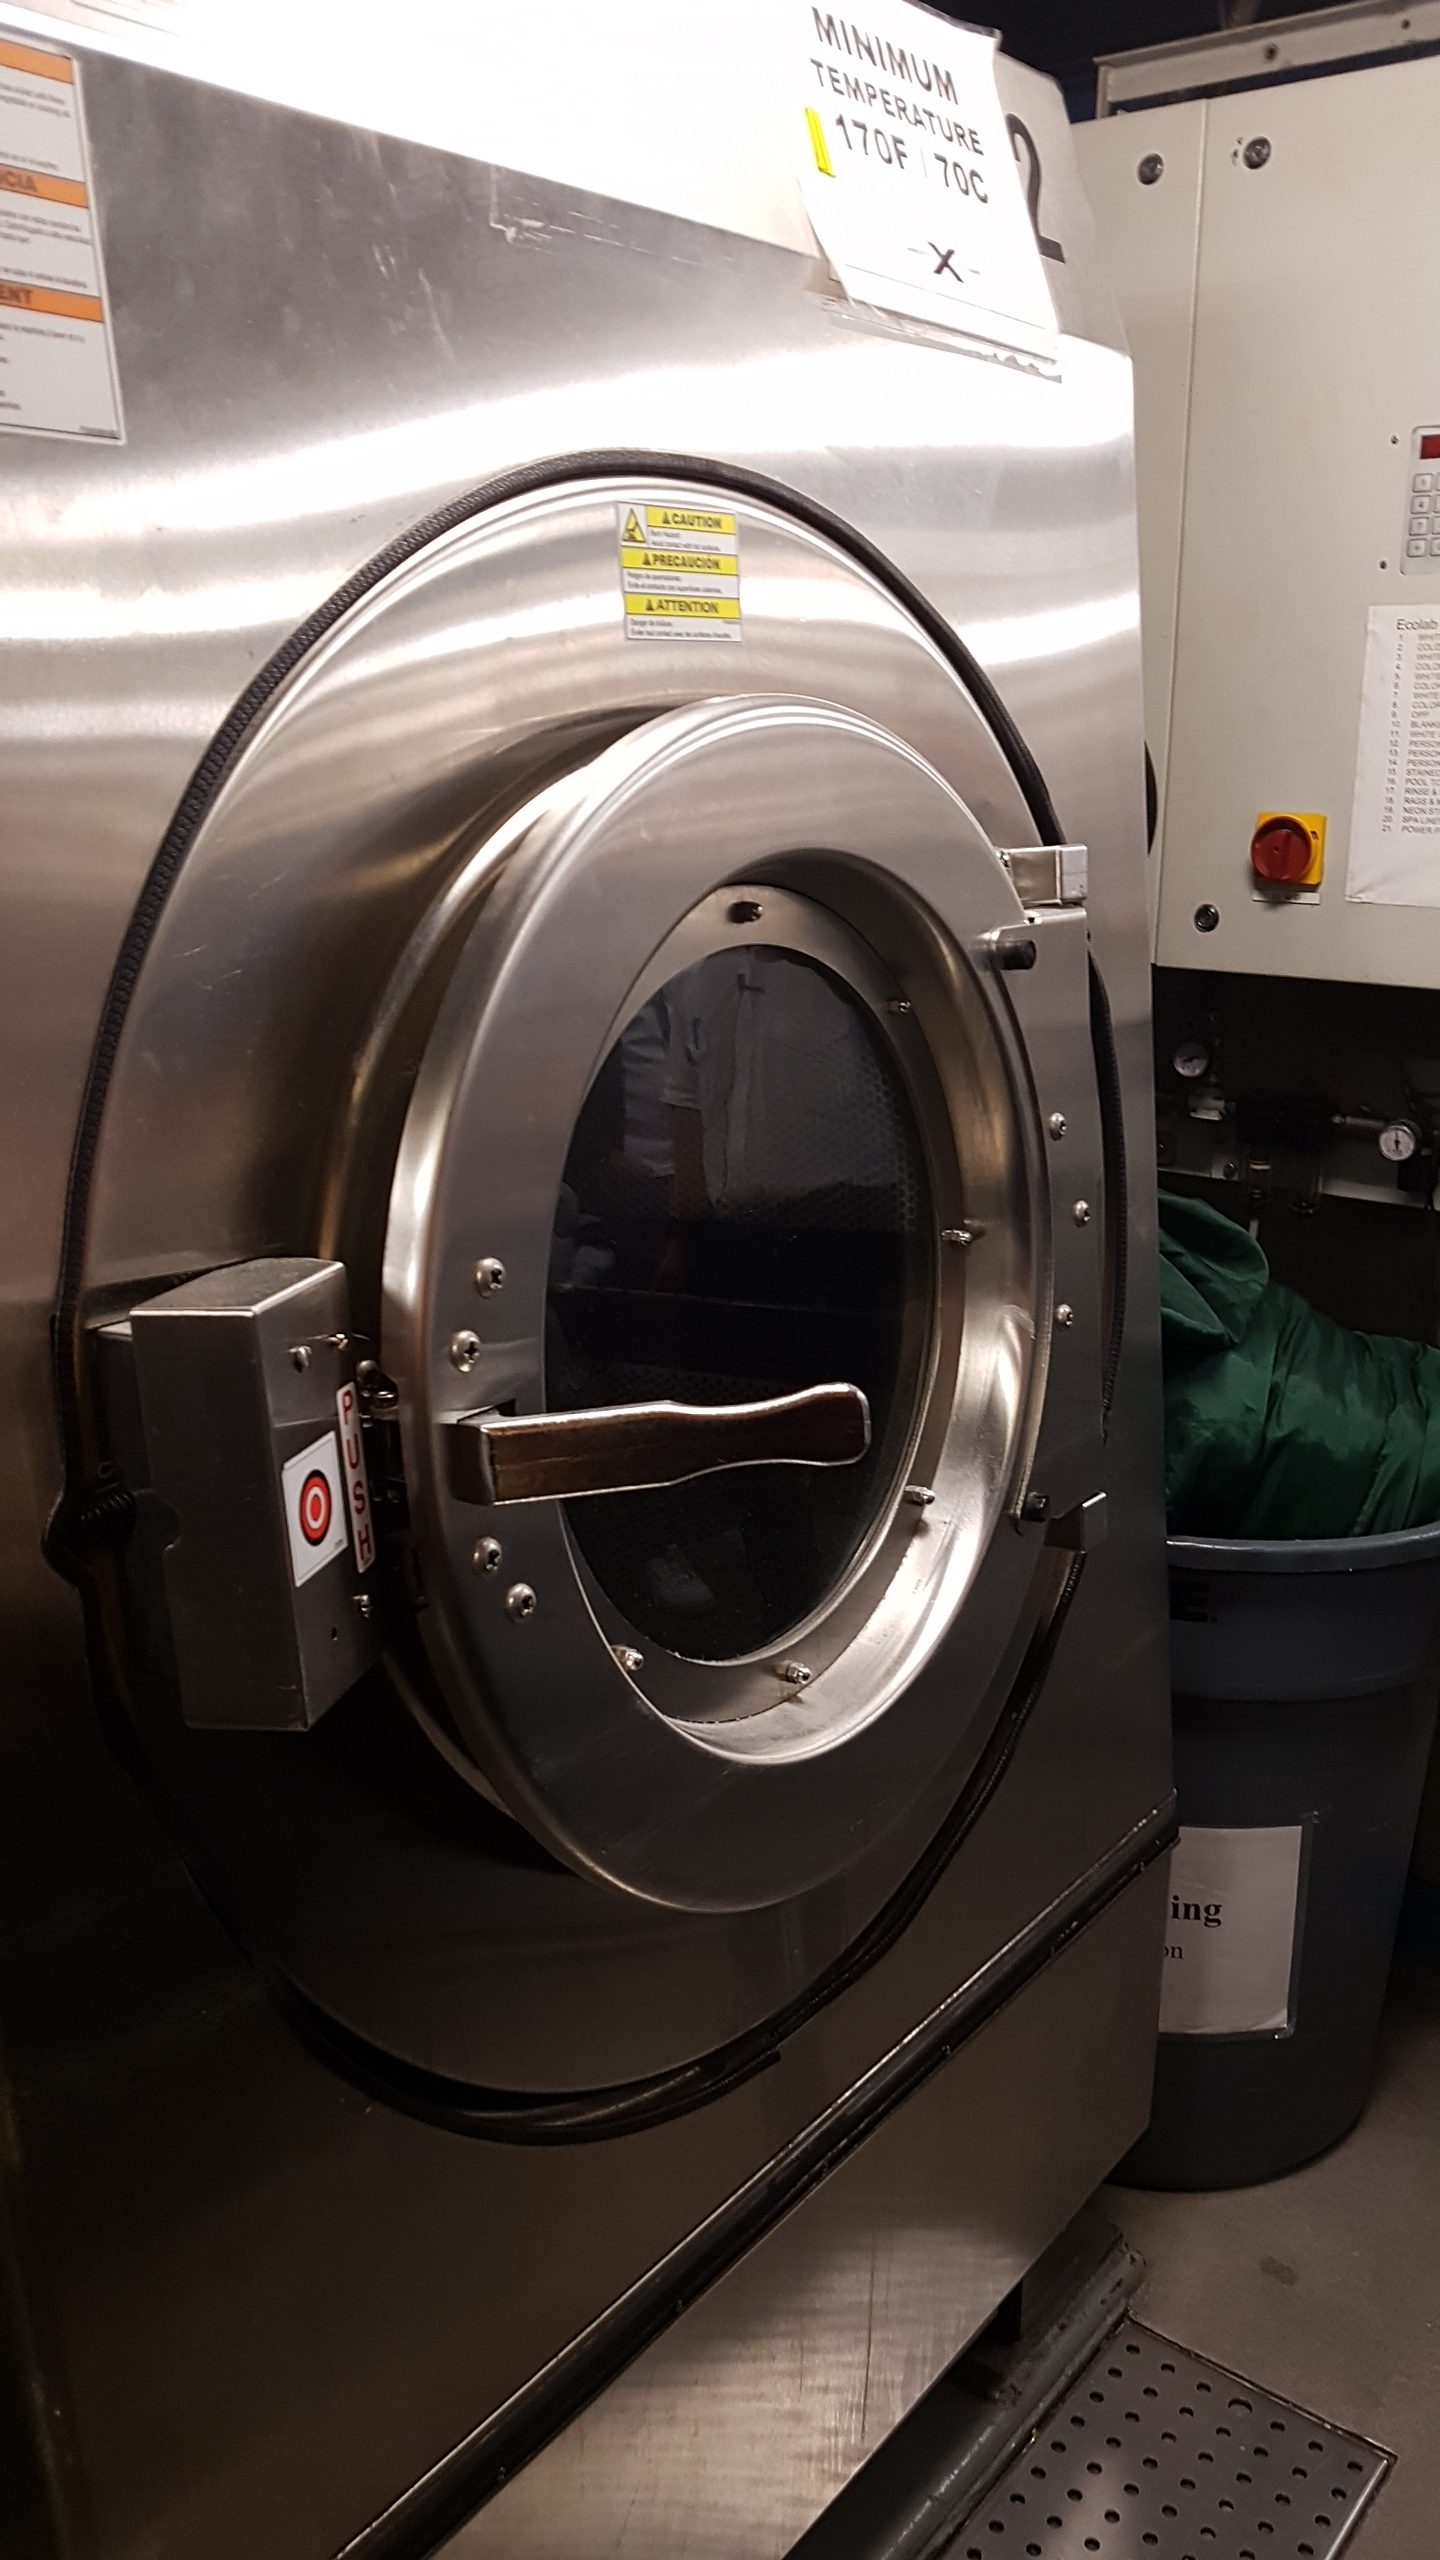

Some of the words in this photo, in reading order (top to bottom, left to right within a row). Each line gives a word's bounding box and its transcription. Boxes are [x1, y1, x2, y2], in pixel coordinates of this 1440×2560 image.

[811, 5, 959, 105] MINIMUM
[810, 57, 984, 156] TEMPERATURE
[835, 113, 908, 170] 170F
[934, 152, 988, 204] 70C
[1005, 112, 1066, 264] 2
[673, 512, 722, 530] CAUTION
[653, 553, 720, 570] PRECAUCIÓN
[657, 599, 719, 614] ATTENTION
[1396, 618, 1438, 631] Ecolab
[1405, 777, 1428, 786] POOL
[1404, 787, 1430, 796] RINSE
[1403, 796, 1428, 805] RAGS
[1402, 805, 1427, 815] NEON
[1401, 815, 1419, 824] SPA
[1401, 825, 1433, 834] POWER
[340, 1389, 373, 1561] PUSH
